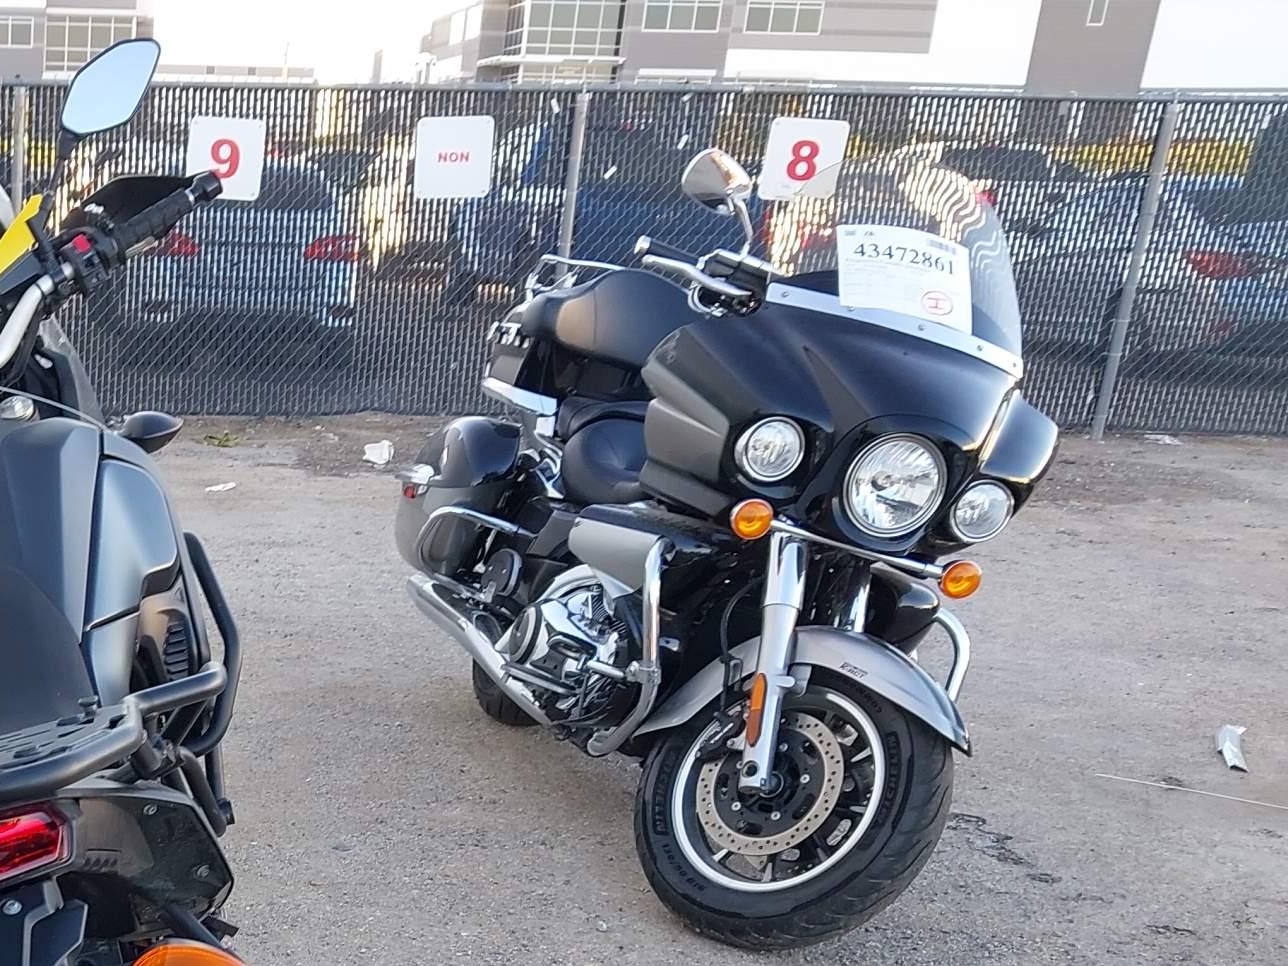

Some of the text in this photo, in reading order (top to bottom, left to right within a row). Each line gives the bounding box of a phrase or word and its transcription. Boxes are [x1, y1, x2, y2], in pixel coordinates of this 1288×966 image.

[211, 138, 240, 179] 9
[437, 151, 470, 163] NON
[786, 139, 819, 181] 8
[853, 243, 954, 275] 43472861
